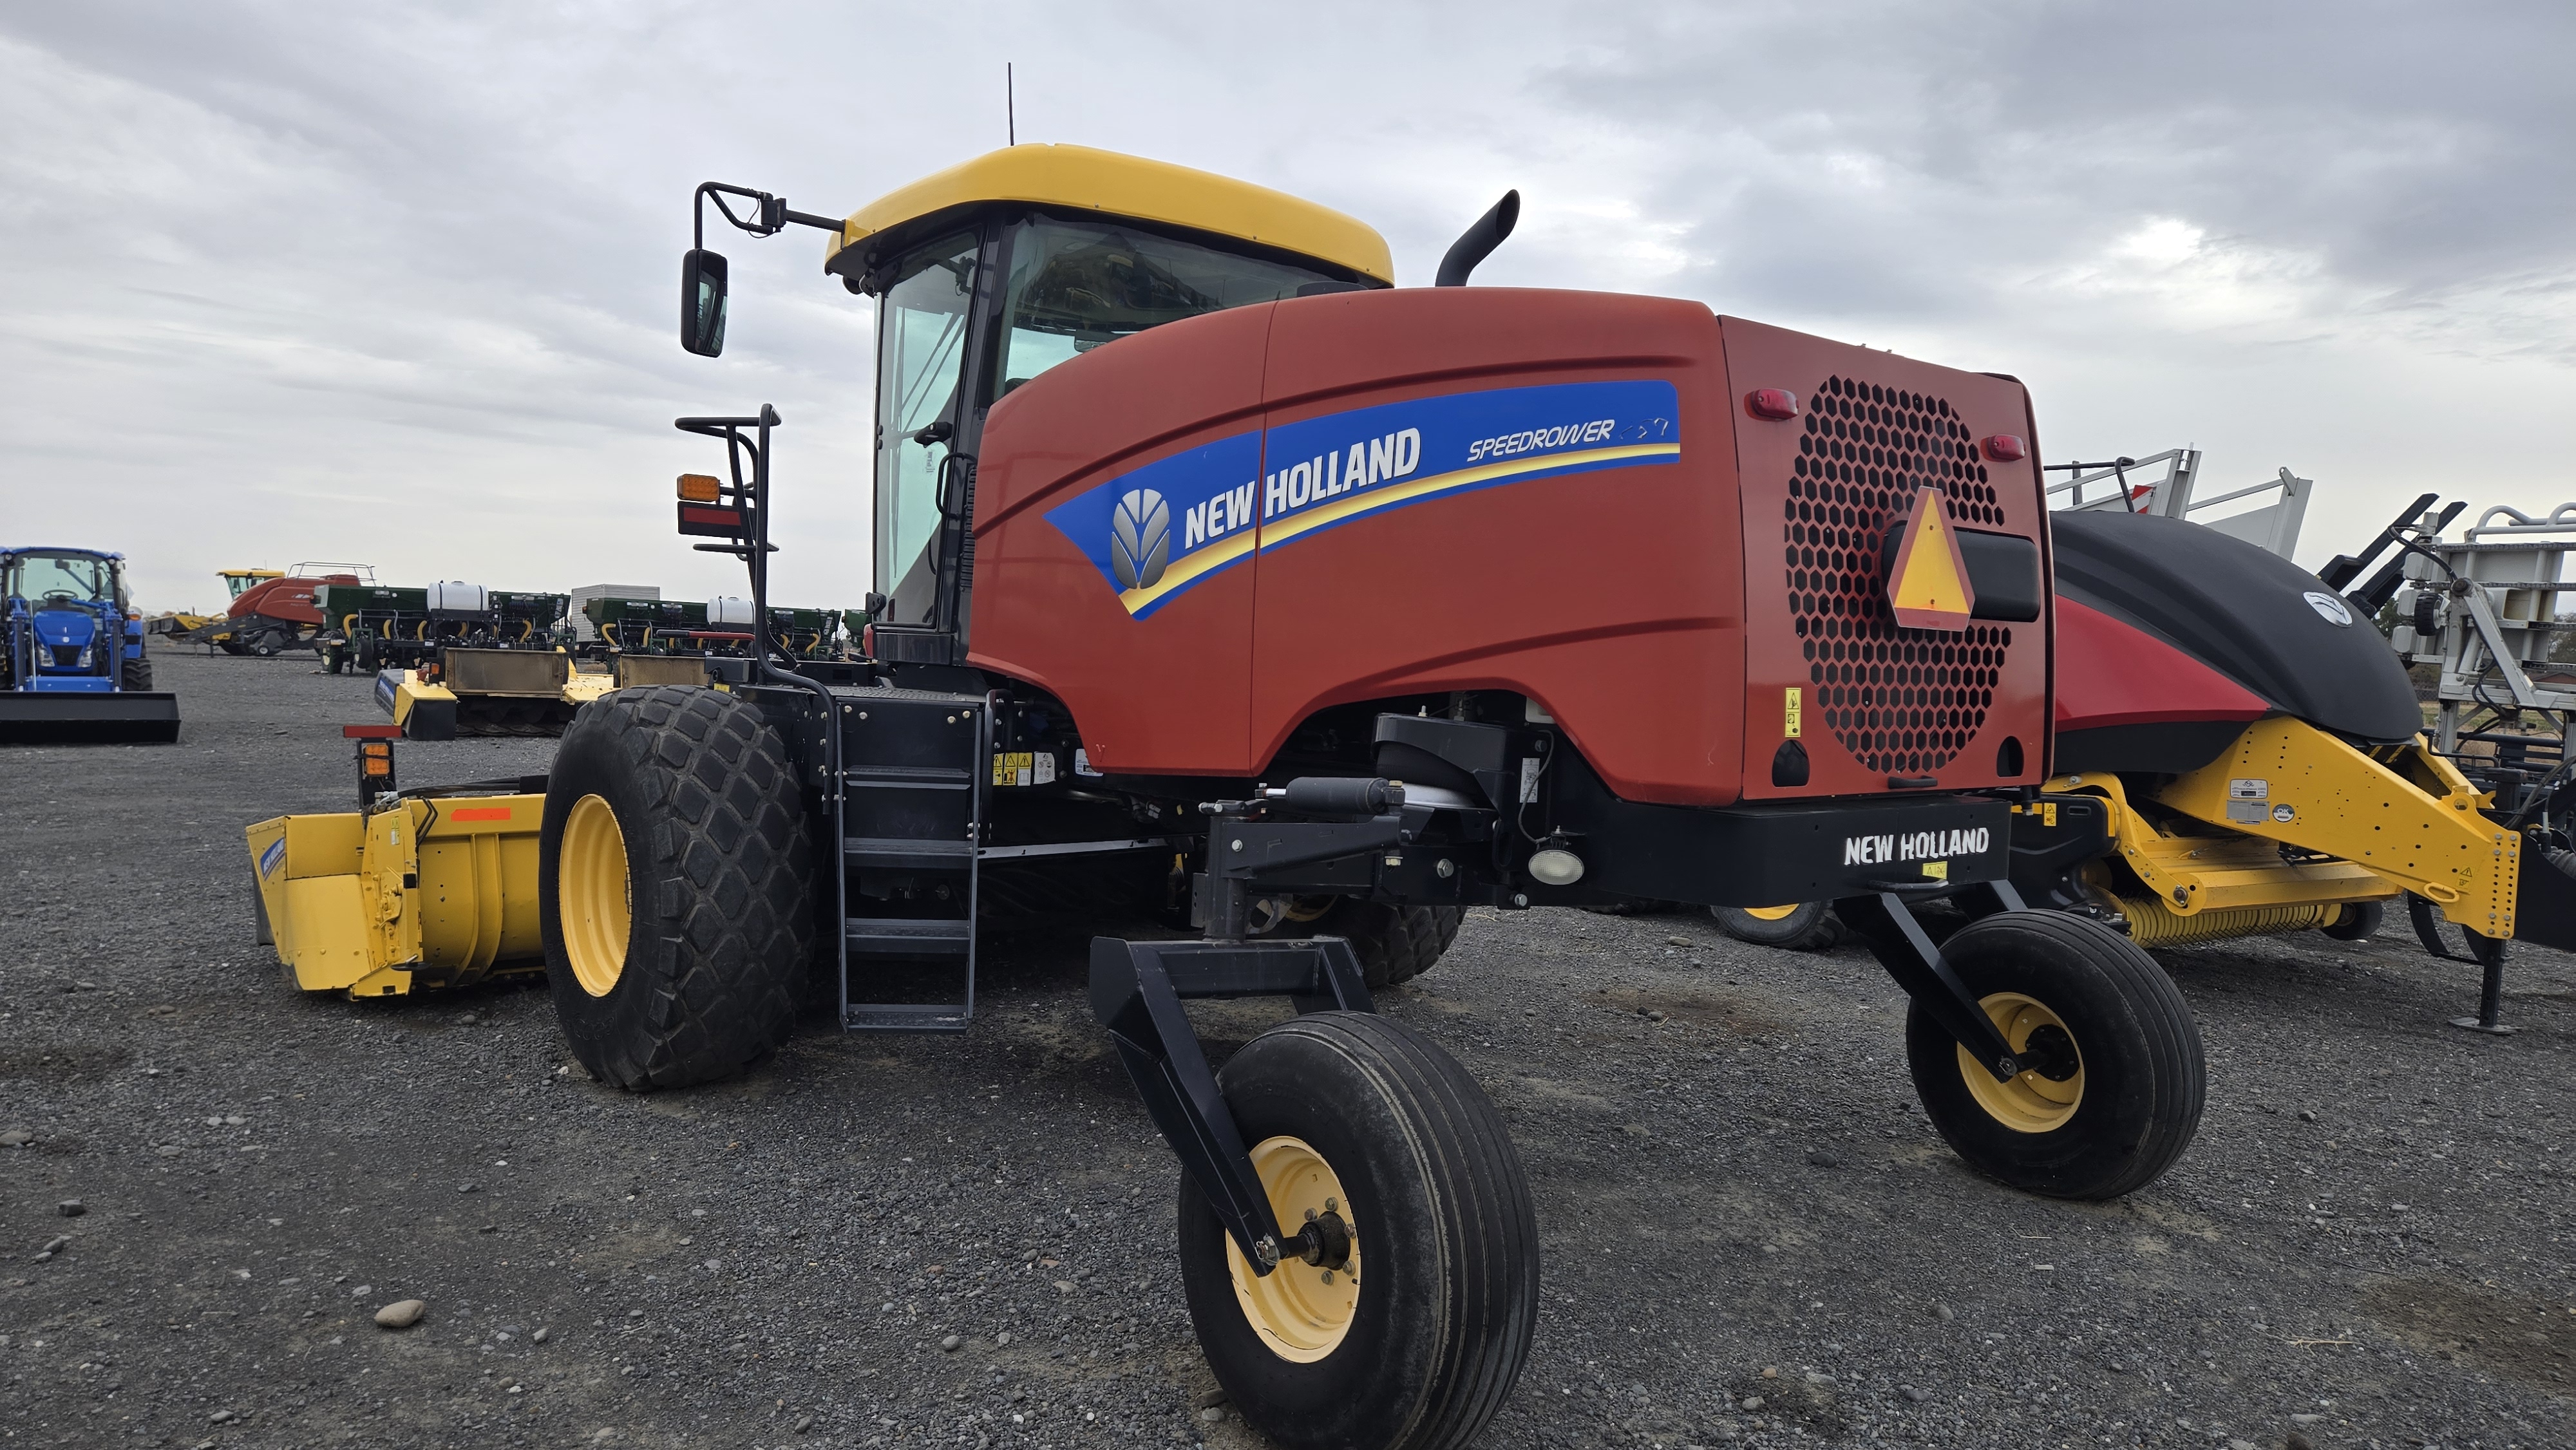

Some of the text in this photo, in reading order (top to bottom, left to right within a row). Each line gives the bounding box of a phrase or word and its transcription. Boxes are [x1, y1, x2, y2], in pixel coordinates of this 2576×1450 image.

[1186, 419, 1615, 549] NEW HOLLAND SPEEDROWER
[1844, 827, 1989, 865] NEW HOLLAND
